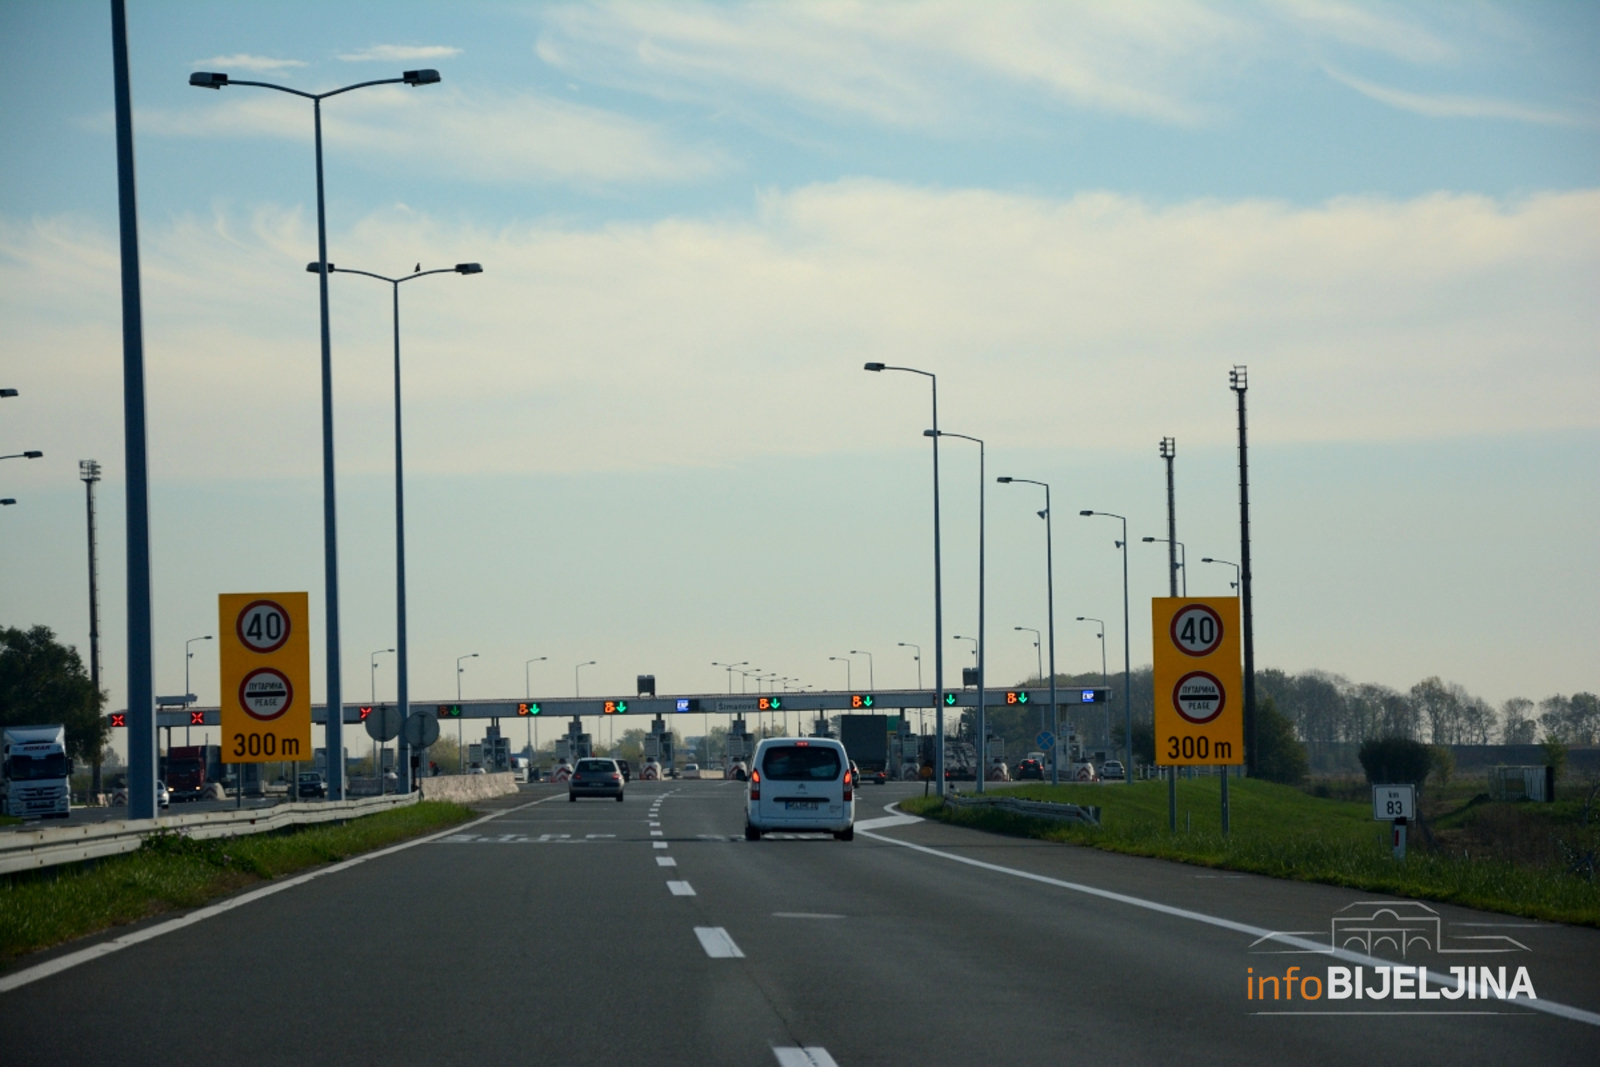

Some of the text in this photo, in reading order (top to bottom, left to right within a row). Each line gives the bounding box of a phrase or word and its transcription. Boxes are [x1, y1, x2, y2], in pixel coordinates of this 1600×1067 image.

[246, 612, 281, 641] 40
[1180, 616, 1214, 644] 40
[249, 682, 283, 691] ПУТАРИНА
[1182, 685, 1216, 693] ПУТАРИНА
[254, 698, 278, 707] PEAGE
[718, 702, 757, 710] Šimanovc
[1188, 701, 1210, 710] PEAGE
[233, 732, 299, 757] 300 m
[1167, 736, 1232, 759] 300 m
[1388, 790, 1400, 799] km
[1386, 801, 1402, 815] 83
